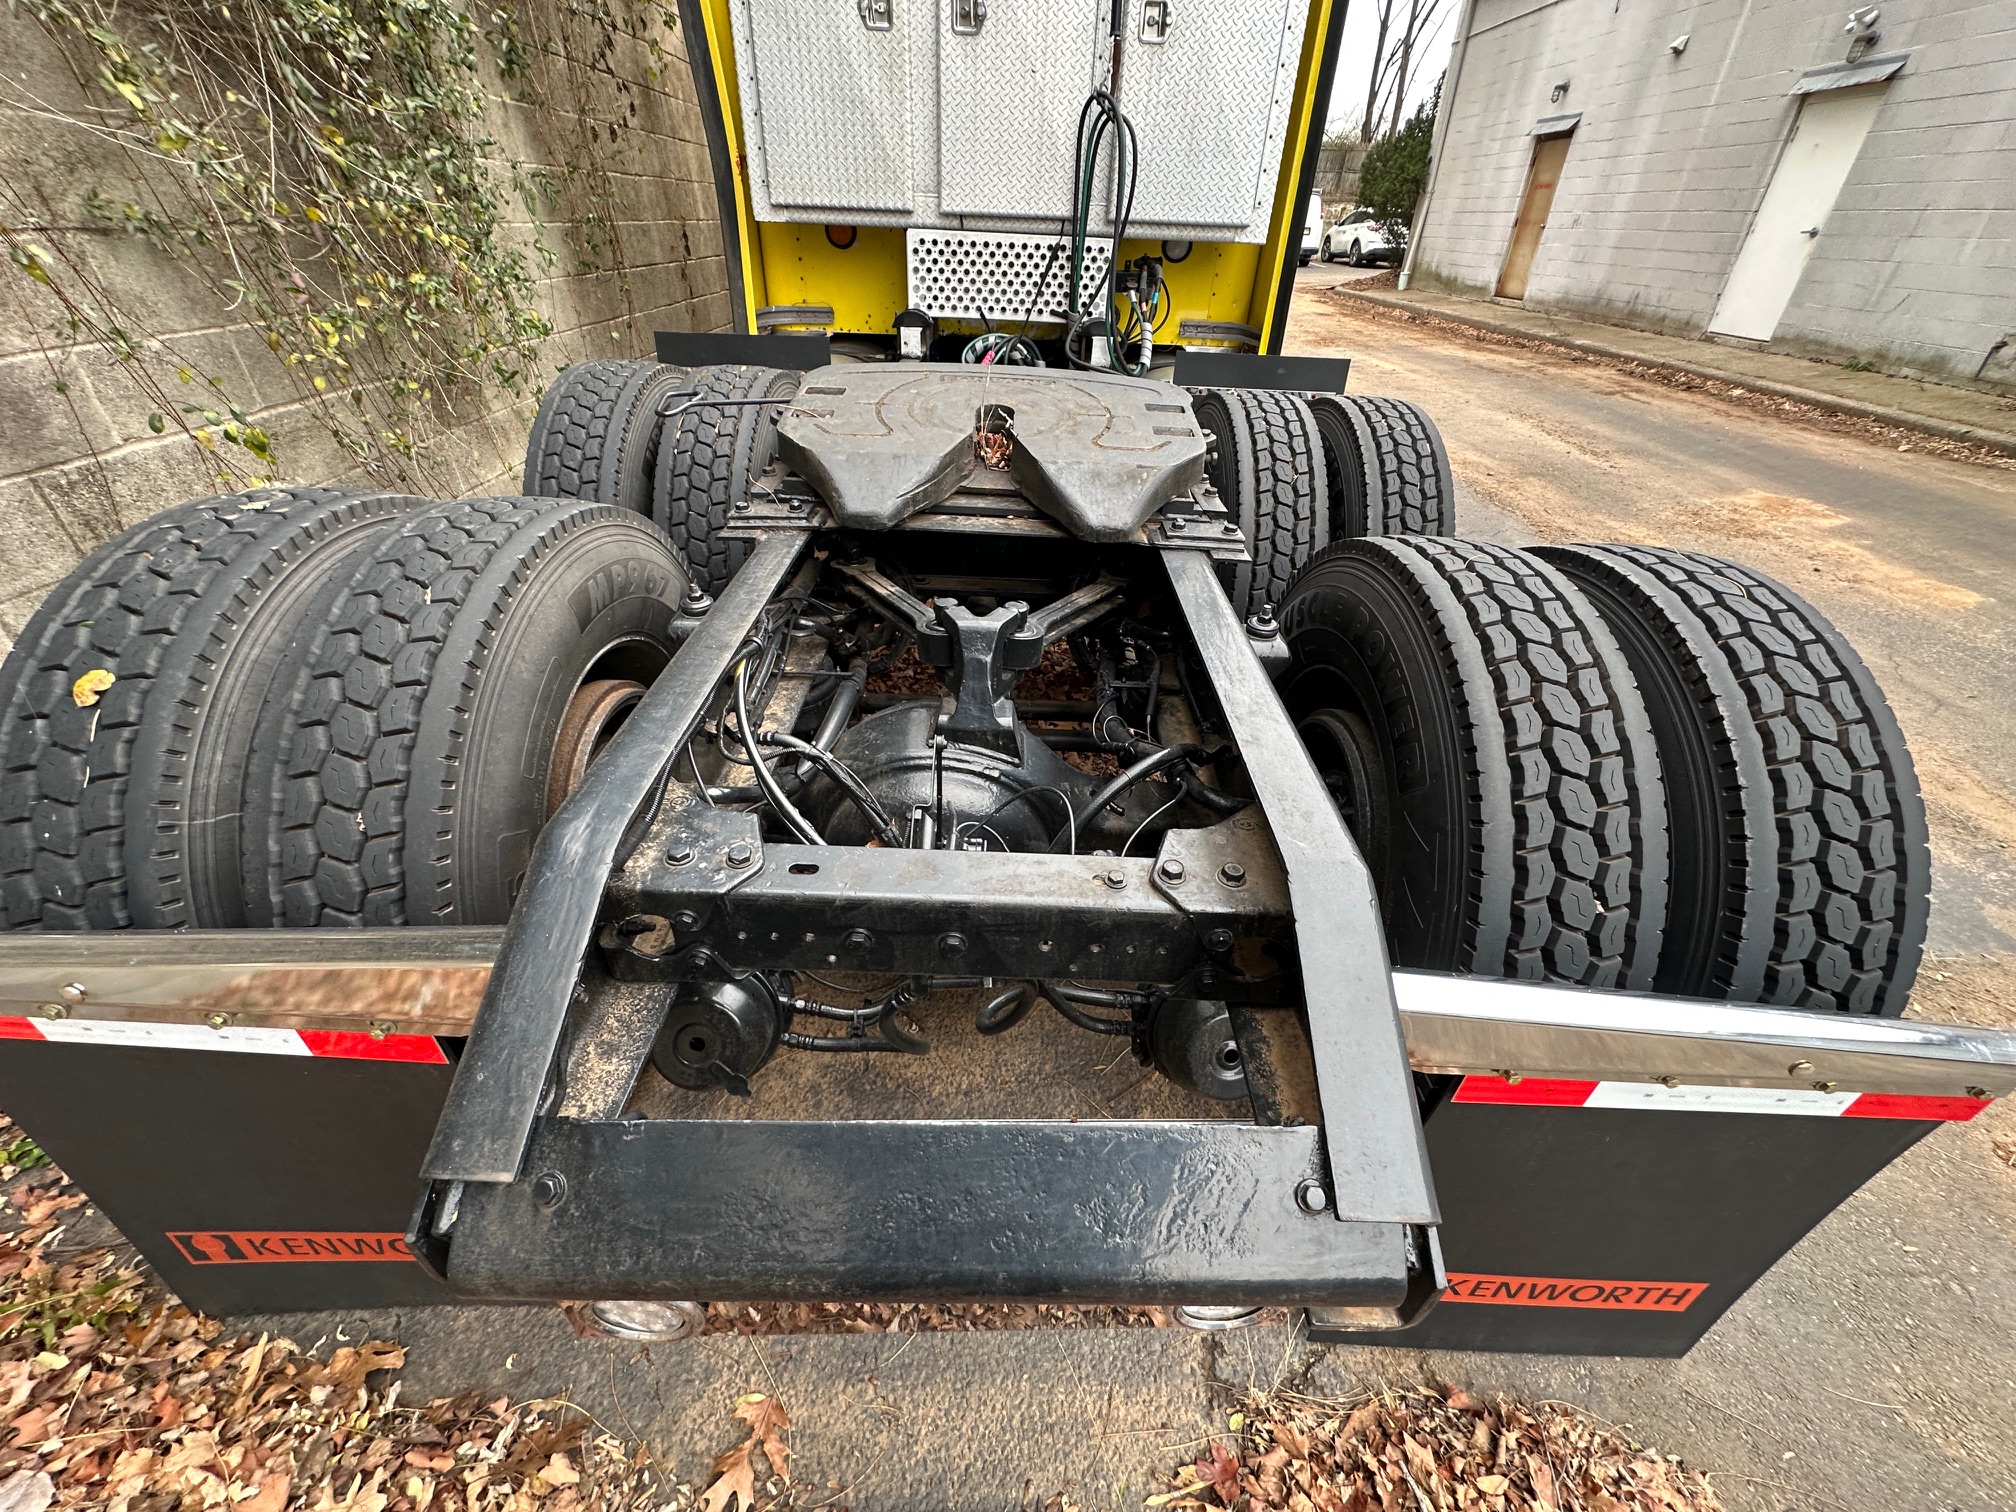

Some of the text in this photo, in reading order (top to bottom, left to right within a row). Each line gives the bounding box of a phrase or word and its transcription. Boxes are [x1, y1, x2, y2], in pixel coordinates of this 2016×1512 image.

[589, 560, 669, 618] MP967
[1279, 590, 1420, 778] USCLE POWER
[1446, 1279, 1692, 1306] KENWORTH
